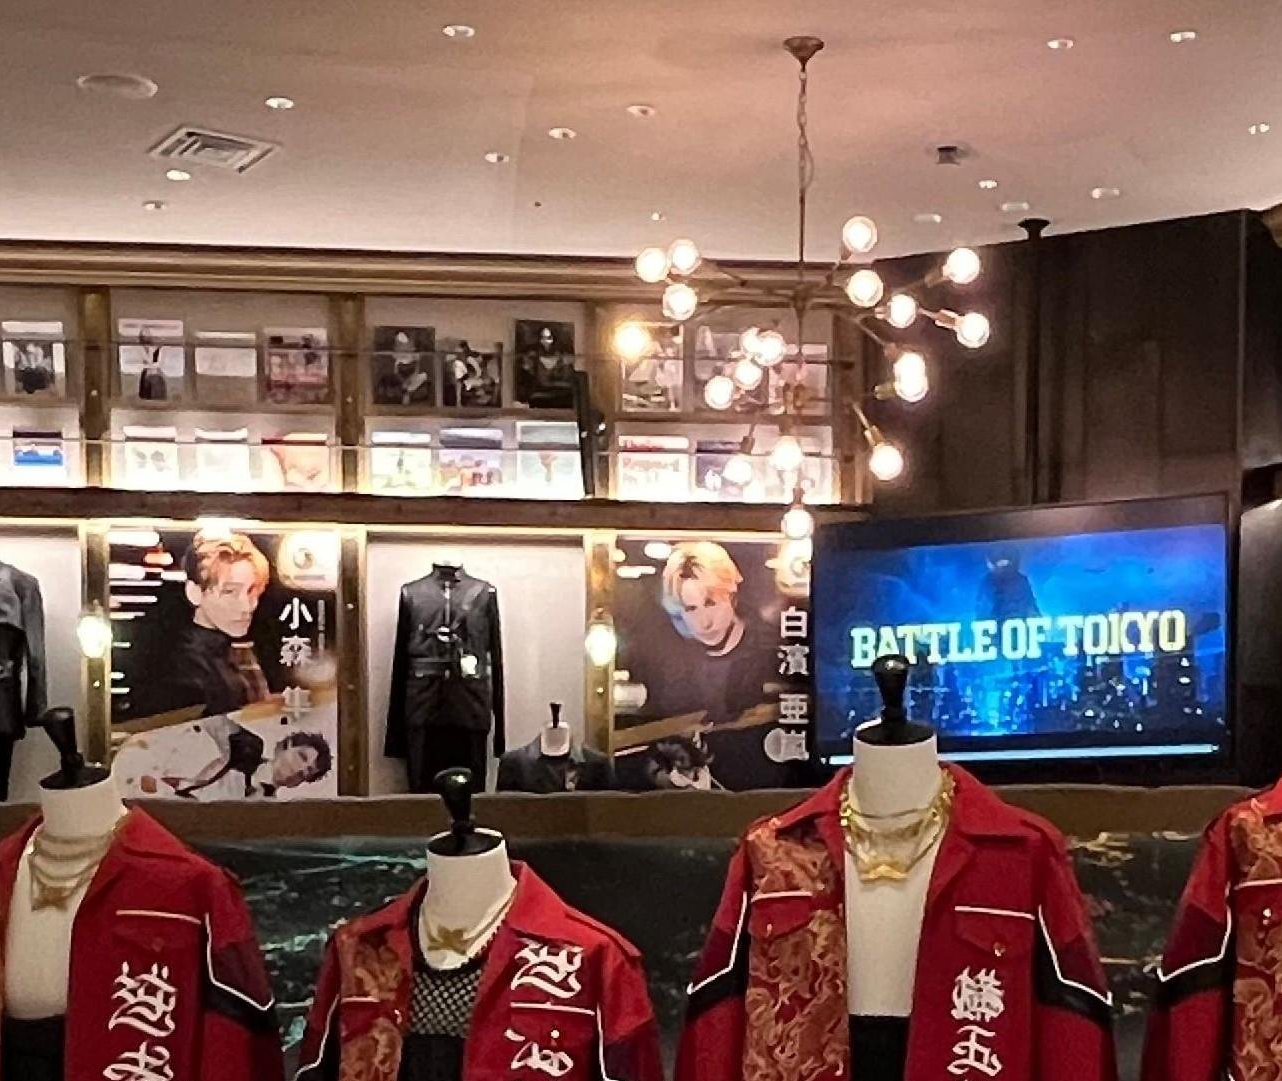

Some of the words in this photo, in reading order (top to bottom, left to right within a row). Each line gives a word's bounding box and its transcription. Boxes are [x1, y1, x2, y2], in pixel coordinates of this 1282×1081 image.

[279, 597, 313, 667] 小森
[777, 606, 810, 675] 白濱
[851, 620, 999, 669] BATTLE
[1001, 616, 1047, 660] OF
[1058, 609, 1186, 656] TOKYO
